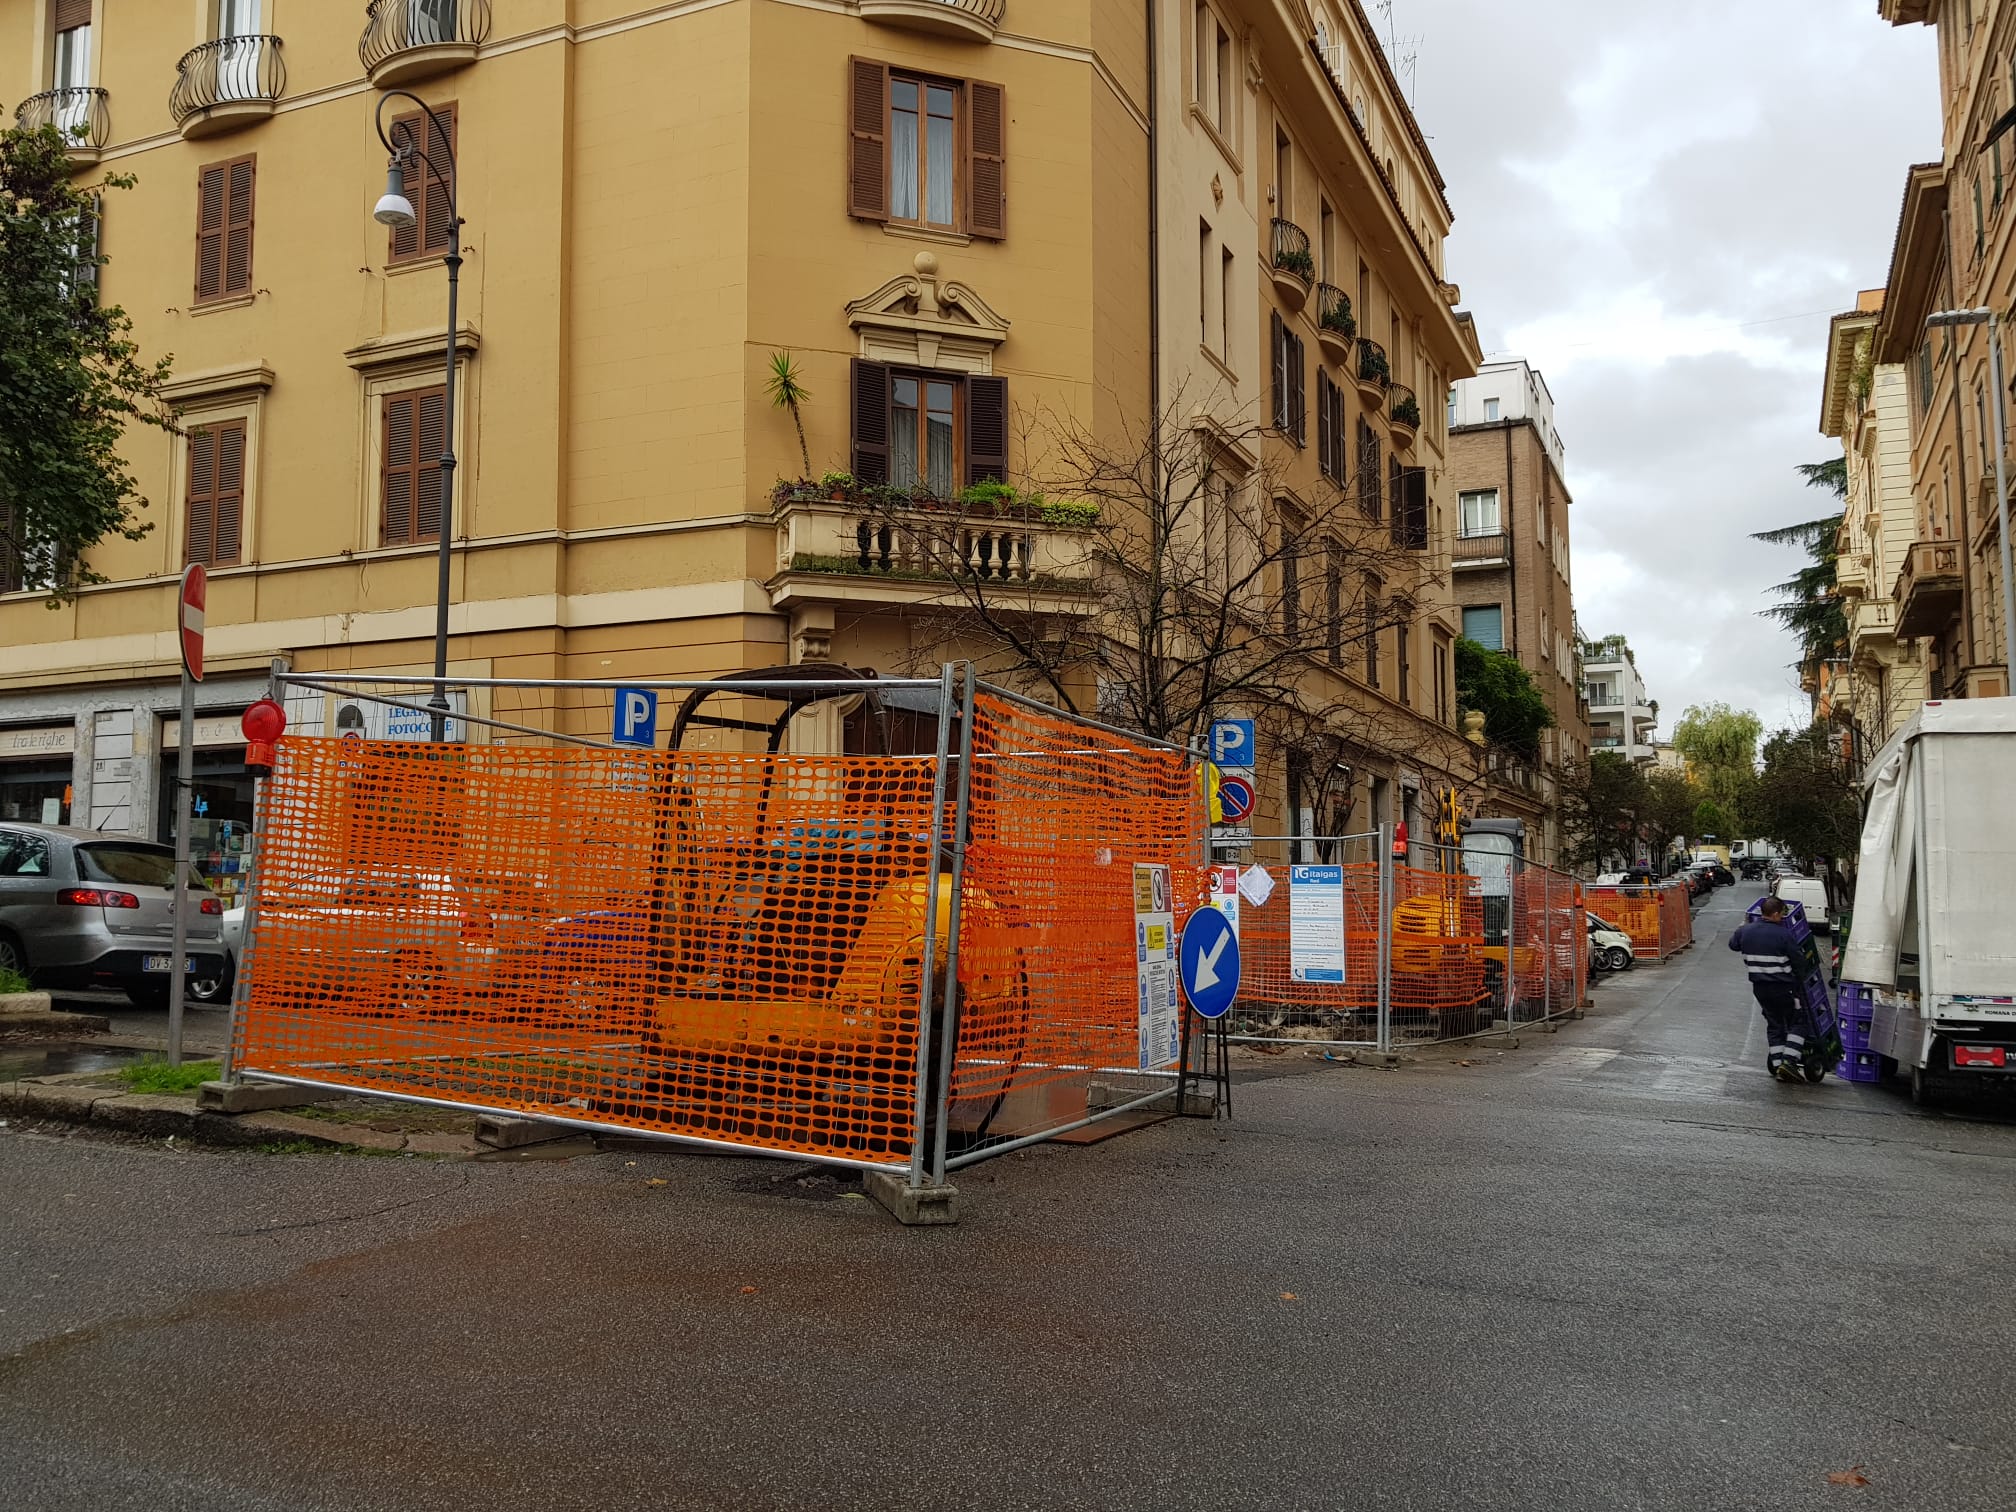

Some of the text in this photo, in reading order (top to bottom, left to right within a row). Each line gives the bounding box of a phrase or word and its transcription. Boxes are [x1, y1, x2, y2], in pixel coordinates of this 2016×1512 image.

[388, 720, 453, 735] FOTOCOE
[624, 692, 650, 737] P
[645, 730, 650, 738] 3
[1215, 724, 1245, 761] P
